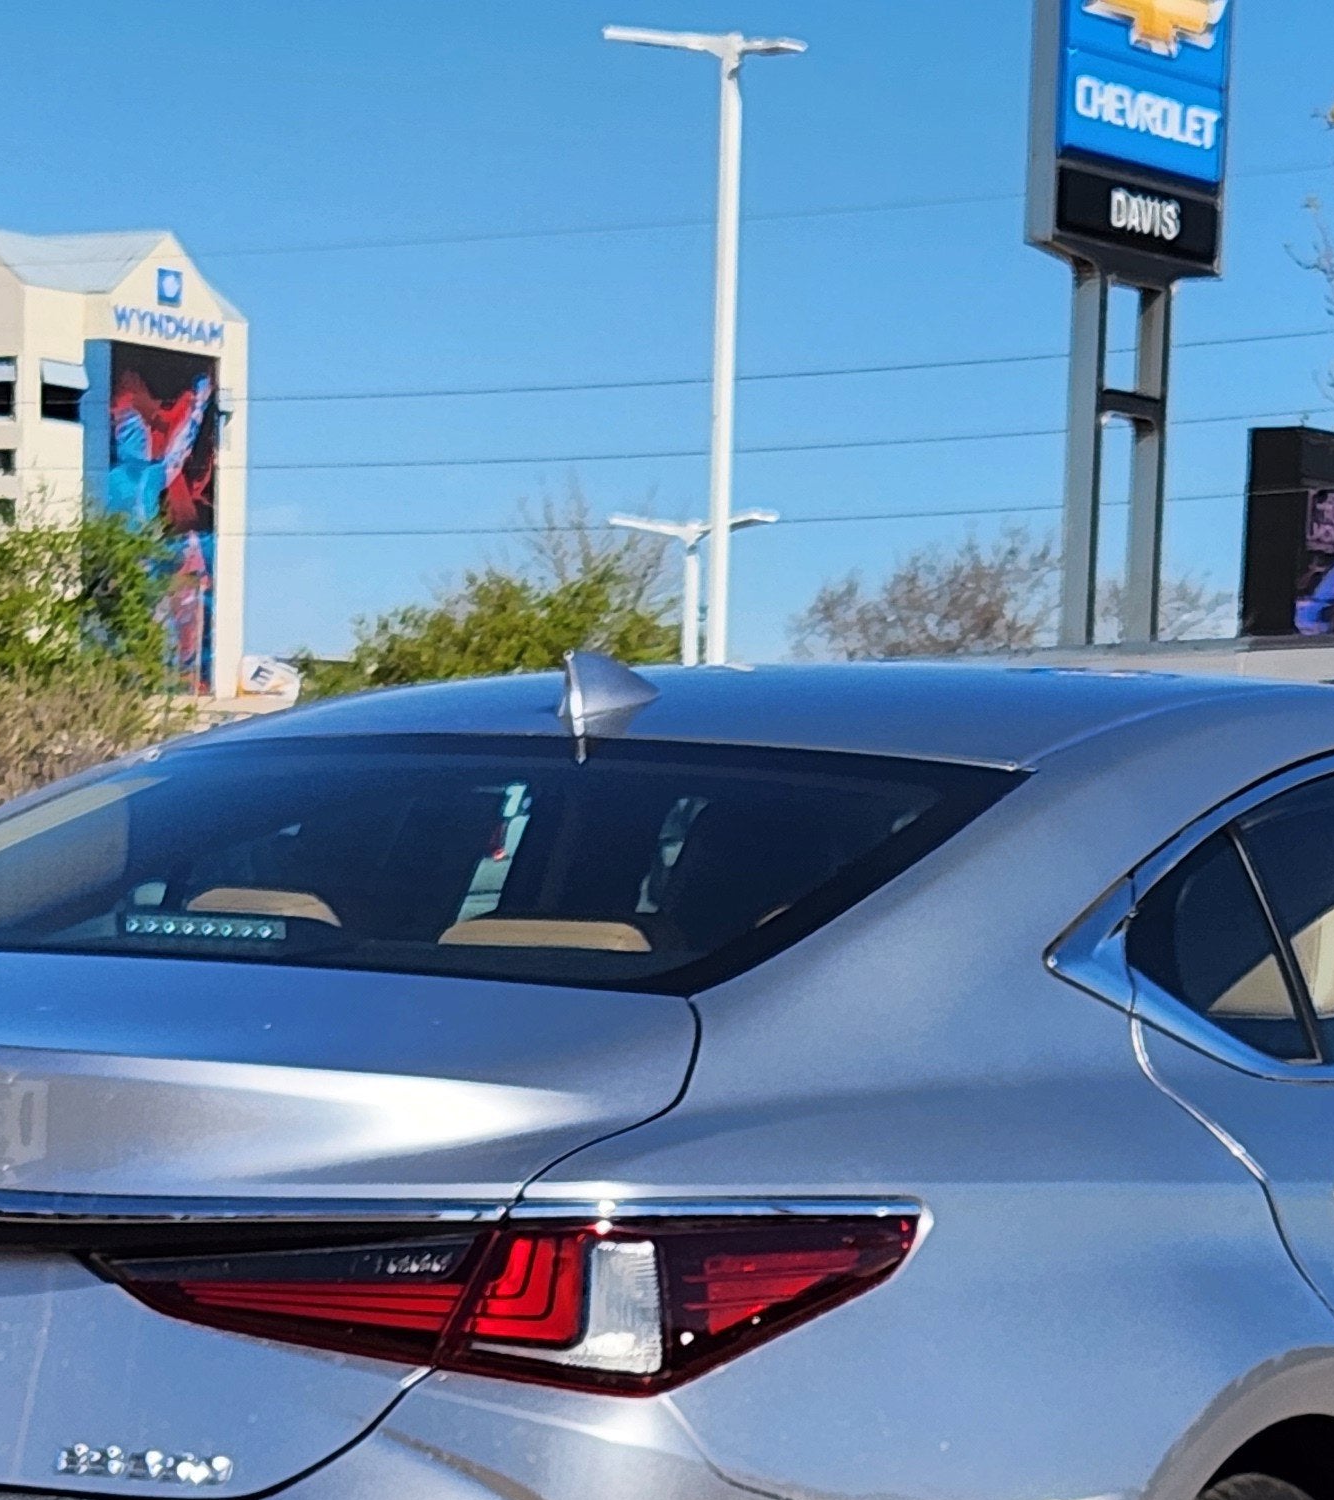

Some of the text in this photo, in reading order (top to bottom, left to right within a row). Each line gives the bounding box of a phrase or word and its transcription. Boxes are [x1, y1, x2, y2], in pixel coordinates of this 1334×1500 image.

[1075, 74, 1221, 150] CHEVROLET
[1110, 187, 1181, 241] DAVIS
[113, 303, 225, 350] WYNDHAM
